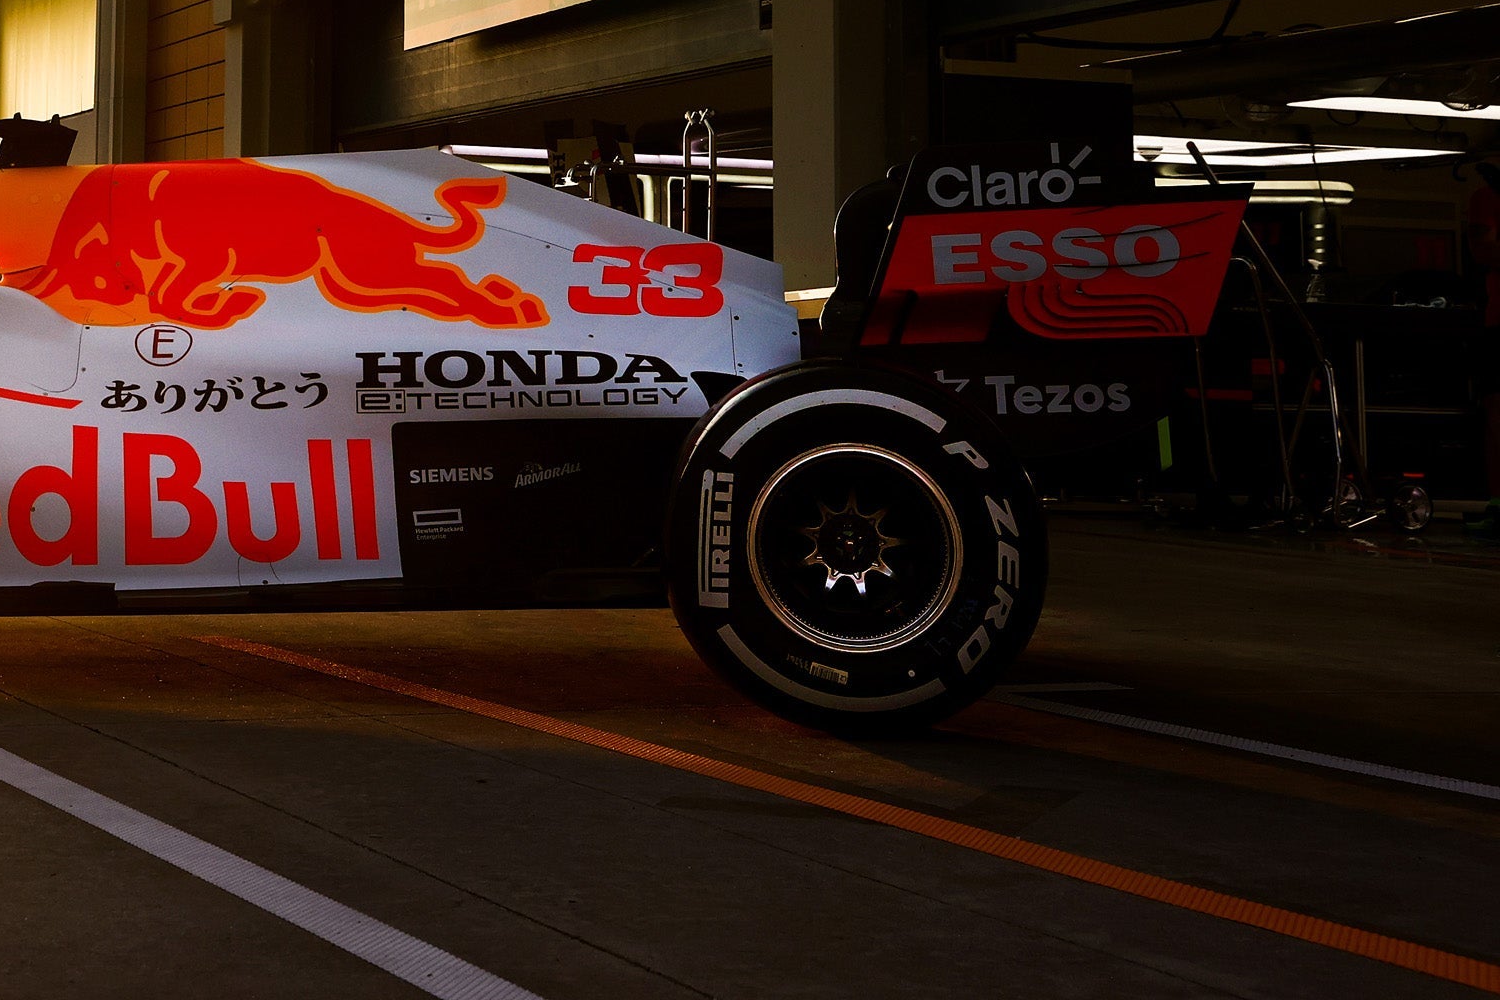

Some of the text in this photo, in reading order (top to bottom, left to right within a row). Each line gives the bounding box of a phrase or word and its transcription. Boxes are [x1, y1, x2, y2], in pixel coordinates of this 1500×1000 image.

[926, 164, 1075, 208] Claro
[930, 223, 1181, 285] ESSO
[568, 242, 724, 318] 33
[152, 329, 176, 360] E
[355, 349, 688, 389] HONDA
[100, 371, 330, 415] ありがとう
[985, 375, 1131, 415] Tezos
[409, 466, 495, 484] SIEMENS
[123, 432, 381, 566] Bull
[699, 469, 734, 609] PIRELLI
[942, 440, 1021, 675] P ZERO
